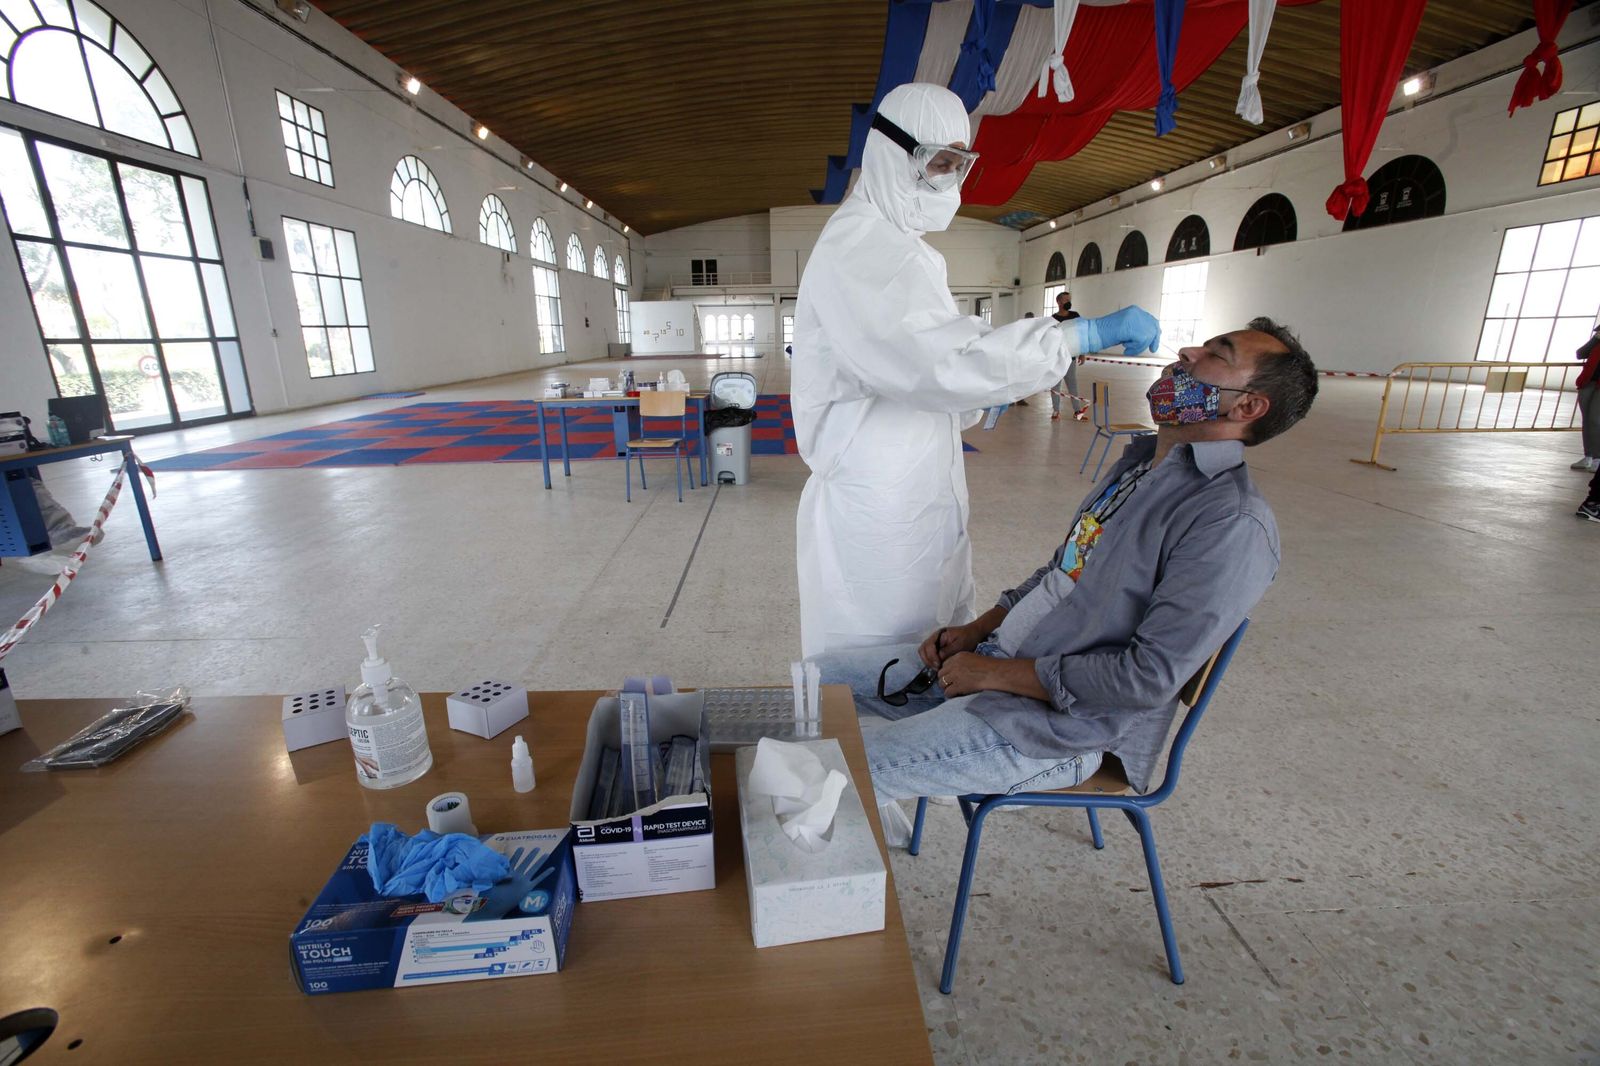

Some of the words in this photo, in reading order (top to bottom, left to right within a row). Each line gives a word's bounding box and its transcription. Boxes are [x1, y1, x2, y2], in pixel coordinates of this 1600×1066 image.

[682, 819, 707, 828] DEVICE
[600, 827, 632, 835] COVID-19
[305, 919, 333, 929] 100
[297, 943, 331, 951] NITRILO
[300, 947, 352, 959] TOUCH
[309, 981, 329, 989] 100
